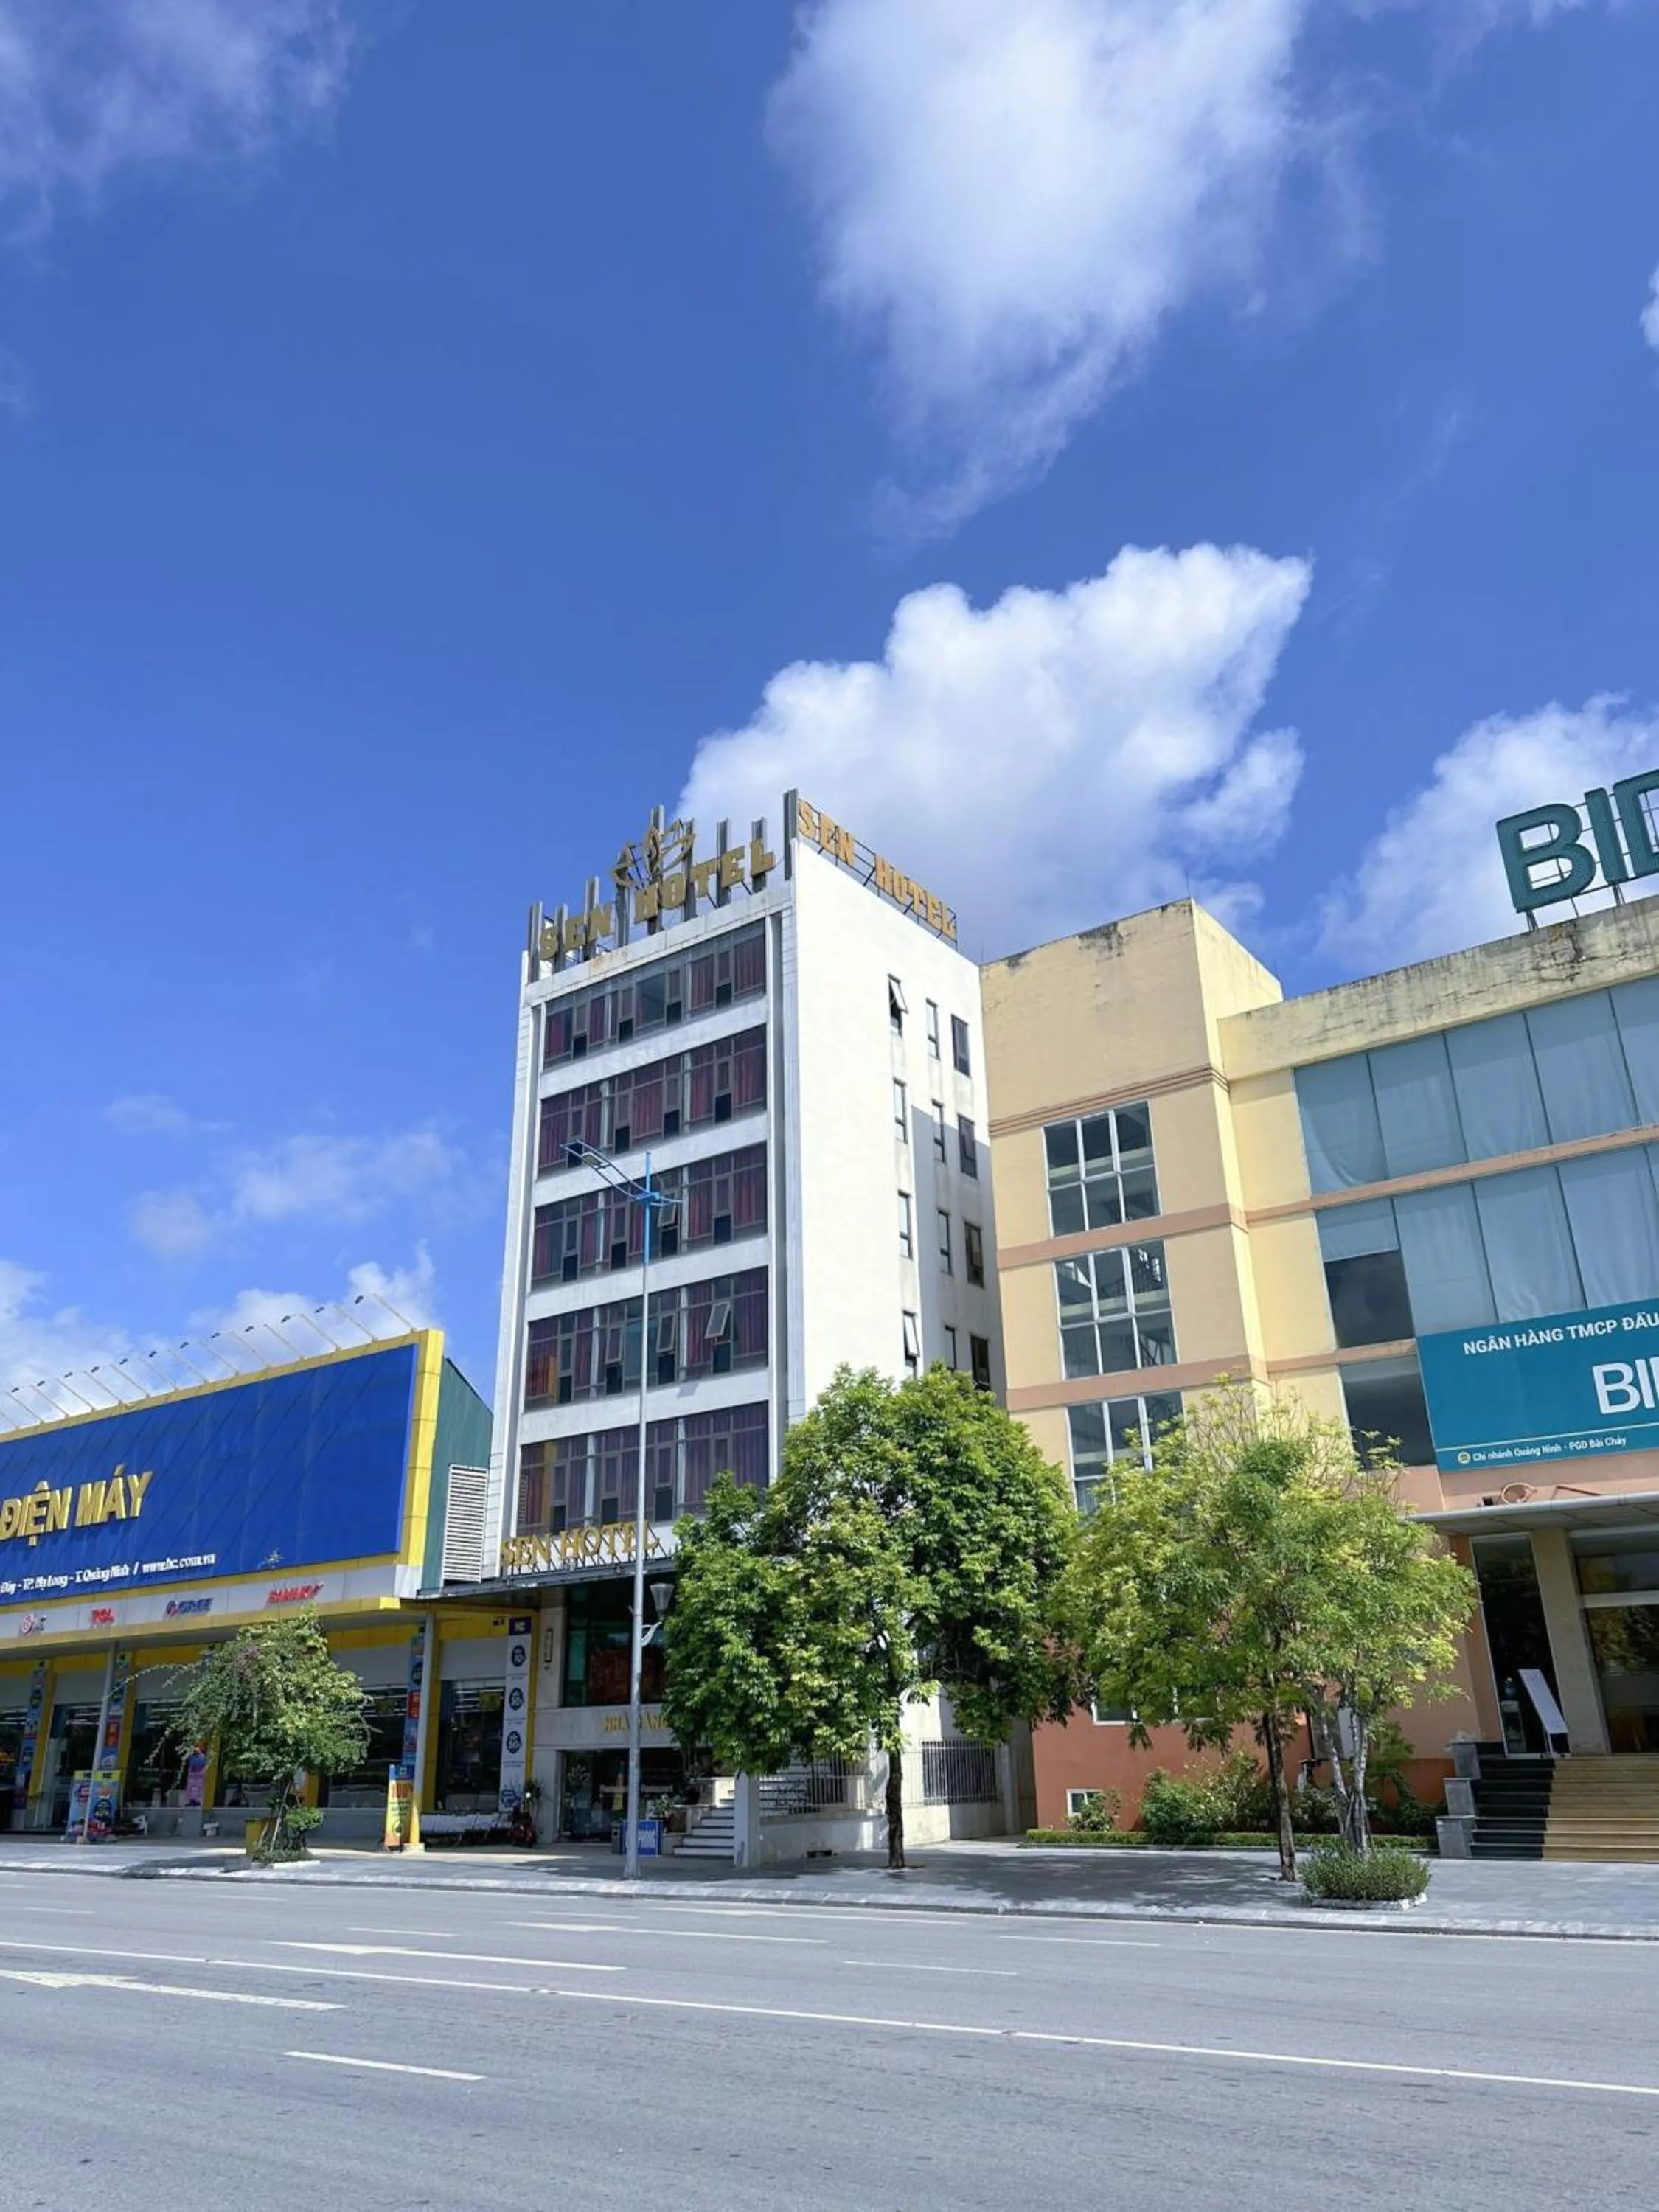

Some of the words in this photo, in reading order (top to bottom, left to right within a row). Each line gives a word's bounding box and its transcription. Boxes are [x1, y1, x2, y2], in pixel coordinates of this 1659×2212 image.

[540, 903, 613, 960] SEN
[634, 838, 775, 923] HOTEL
[799, 801, 855, 866] SEN
[874, 854, 956, 940] HOTEL
[1463, 1335, 1511, 1355] NGÂN
[1514, 1329, 1564, 1348] HÀNG
[1566, 1320, 1618, 1340] TMCP
[1592, 1356, 1659, 1415] BI
[0, 1481, 73, 1546] ĐIỆN
[74, 1463, 153, 1528] MÁY
[501, 1533, 553, 1567] SEN
[559, 1520, 659, 1560] HOTEL
